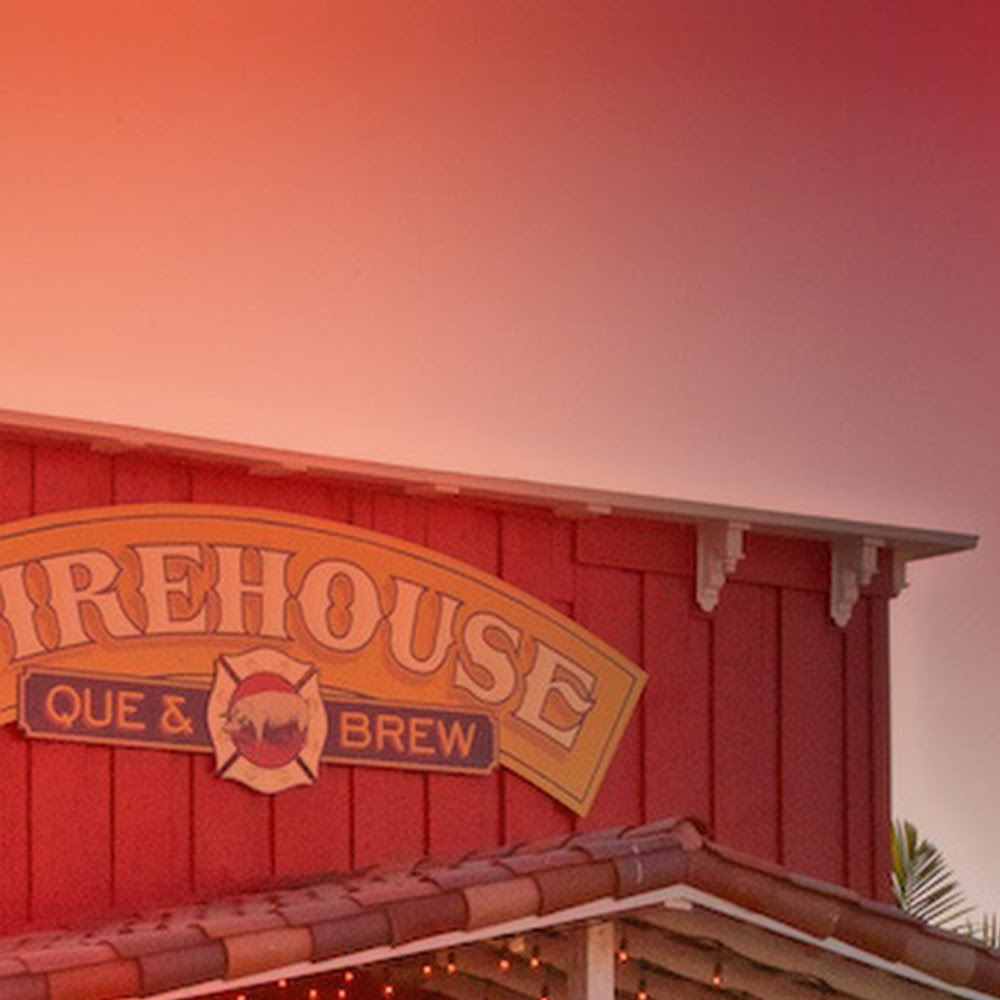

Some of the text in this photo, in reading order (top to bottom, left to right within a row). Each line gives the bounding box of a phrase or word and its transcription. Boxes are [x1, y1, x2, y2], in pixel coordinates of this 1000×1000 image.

[45, 684, 479, 758] QUE & BREW
